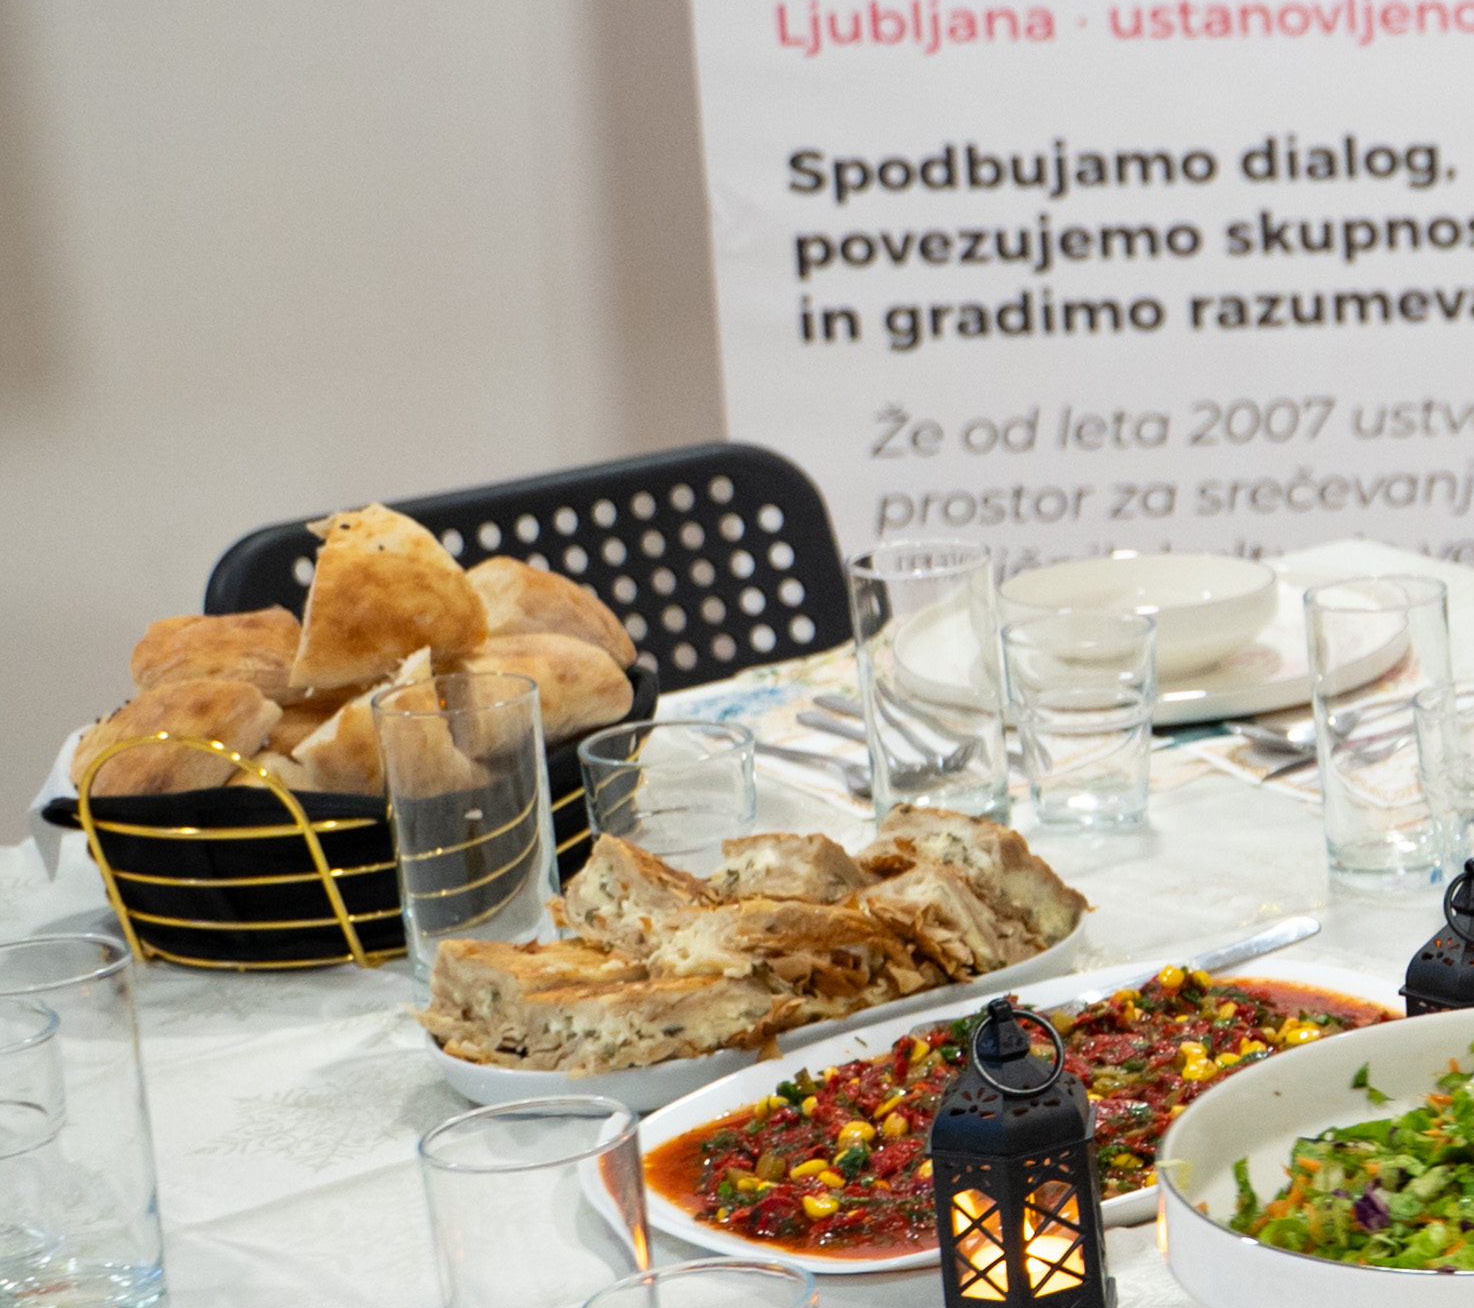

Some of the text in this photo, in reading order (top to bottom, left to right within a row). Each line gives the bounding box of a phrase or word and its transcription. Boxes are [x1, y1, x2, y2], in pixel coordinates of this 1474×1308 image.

[787, 139, 1219, 204] Spodbujamo
[793, 218, 1203, 281] povezujemo
[799, 296, 862, 345] in
[883, 288, 1167, 353] gradimo
[869, 403, 946, 461] Že
[959, 406, 1041, 456] od
[1056, 404, 1172, 452] leta
[1187, 395, 1337, 448] 2007
[874, 482, 1093, 540] prostor
[1108, 481, 1178, 521] za
